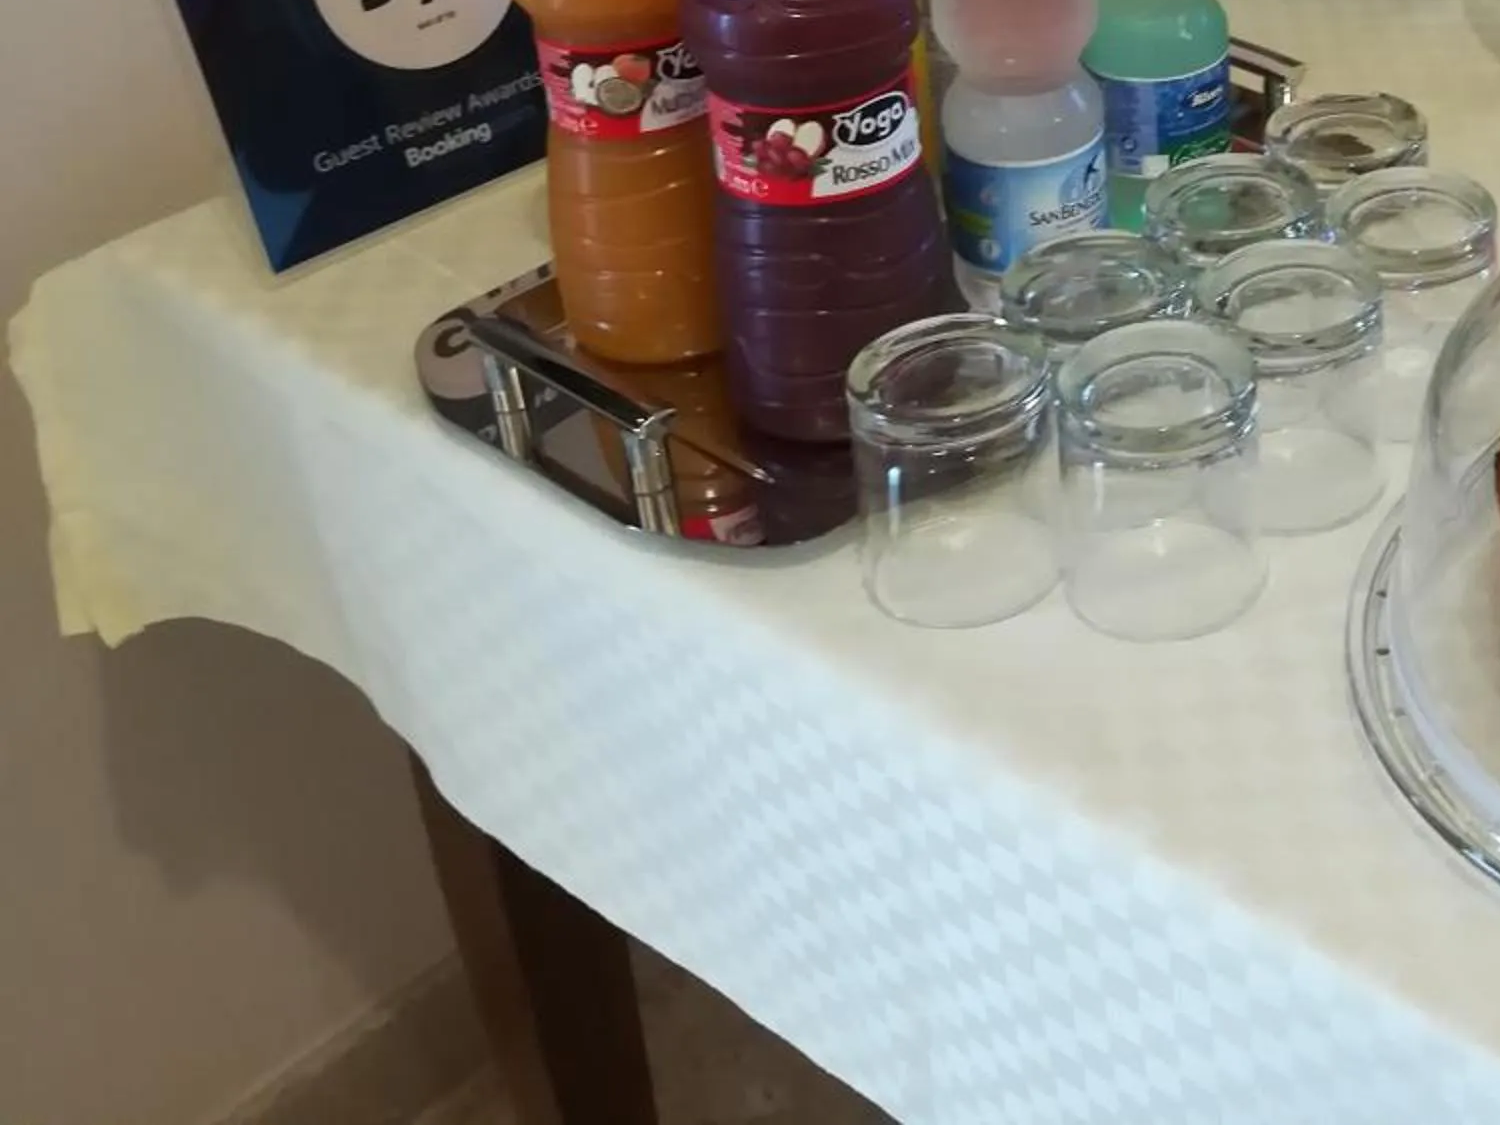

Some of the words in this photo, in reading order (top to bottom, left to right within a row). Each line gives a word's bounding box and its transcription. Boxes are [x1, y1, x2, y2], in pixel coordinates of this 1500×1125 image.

[312, 134, 384, 173] Guest
[384, 103, 463, 145] Review
[841, 100, 905, 142] Yoga
[403, 122, 493, 169] Booking
